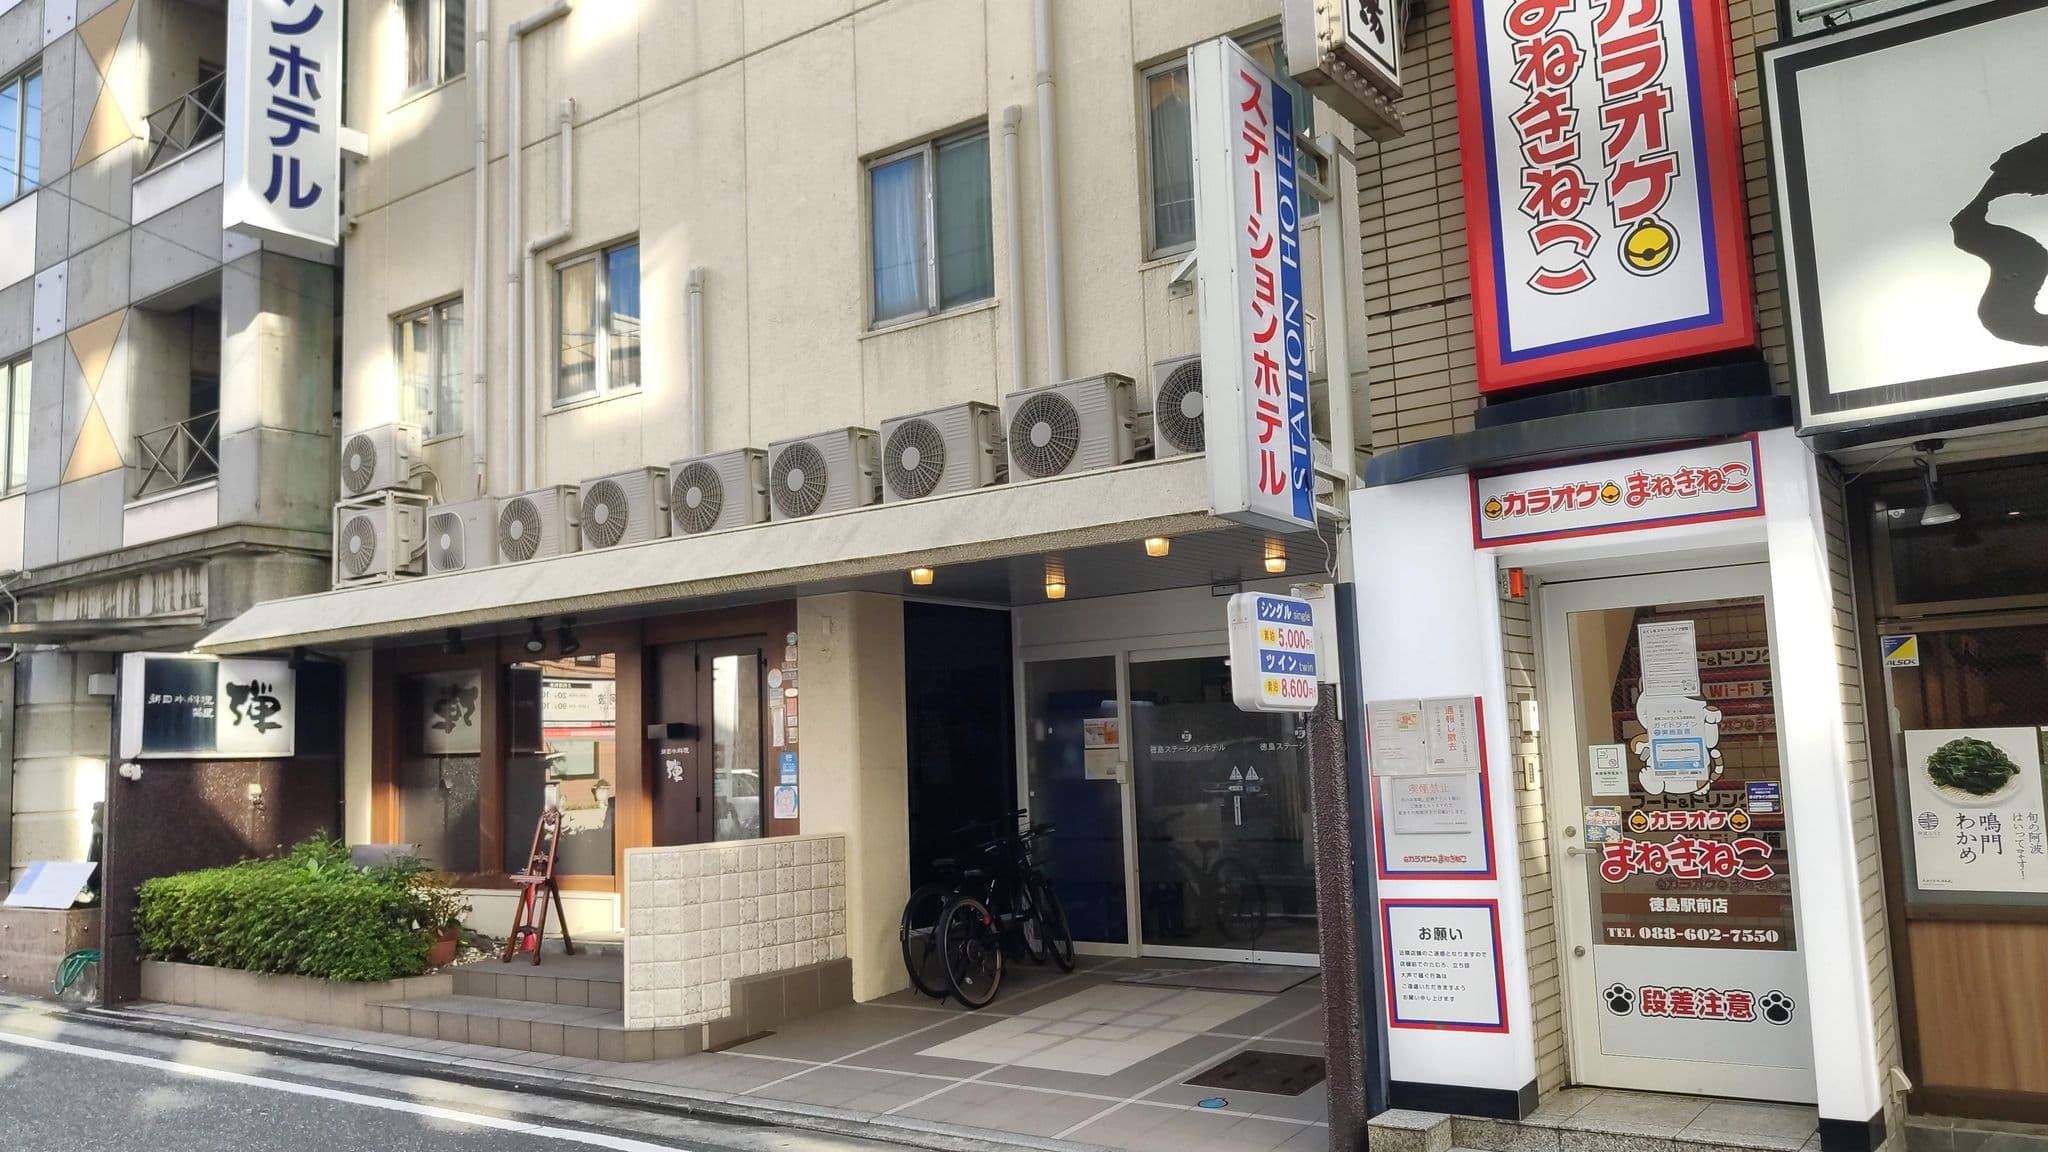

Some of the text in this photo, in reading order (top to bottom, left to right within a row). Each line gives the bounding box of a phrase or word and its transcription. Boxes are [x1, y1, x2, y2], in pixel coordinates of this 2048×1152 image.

[1240, 68, 1287, 496] ステーションホテル
[1275, 119, 1308, 491] STATION HOTEL
[1502, 460, 1752, 519] カラオケ まねきねこ
[1261, 601, 1311, 623] シングル single
[1266, 654, 1313, 673] ツイン twin
[1709, 683, 1755, 698] Wi-Fi
[1650, 811, 1728, 831] カラオケ
[1956, 812, 1977, 865] わかめ
[1979, 812, 2003, 855] 鳴門
[2027, 812, 2044, 855] 旬の阿波
[1600, 834, 1776, 883] まねきねこ
[1649, 896, 1729, 914] 徳島駅前店
[1418, 926, 1463, 941] お願い
[1607, 926, 1779, 943] TEL 088-602-7550
[1640, 986, 1754, 1021] 段差注意
